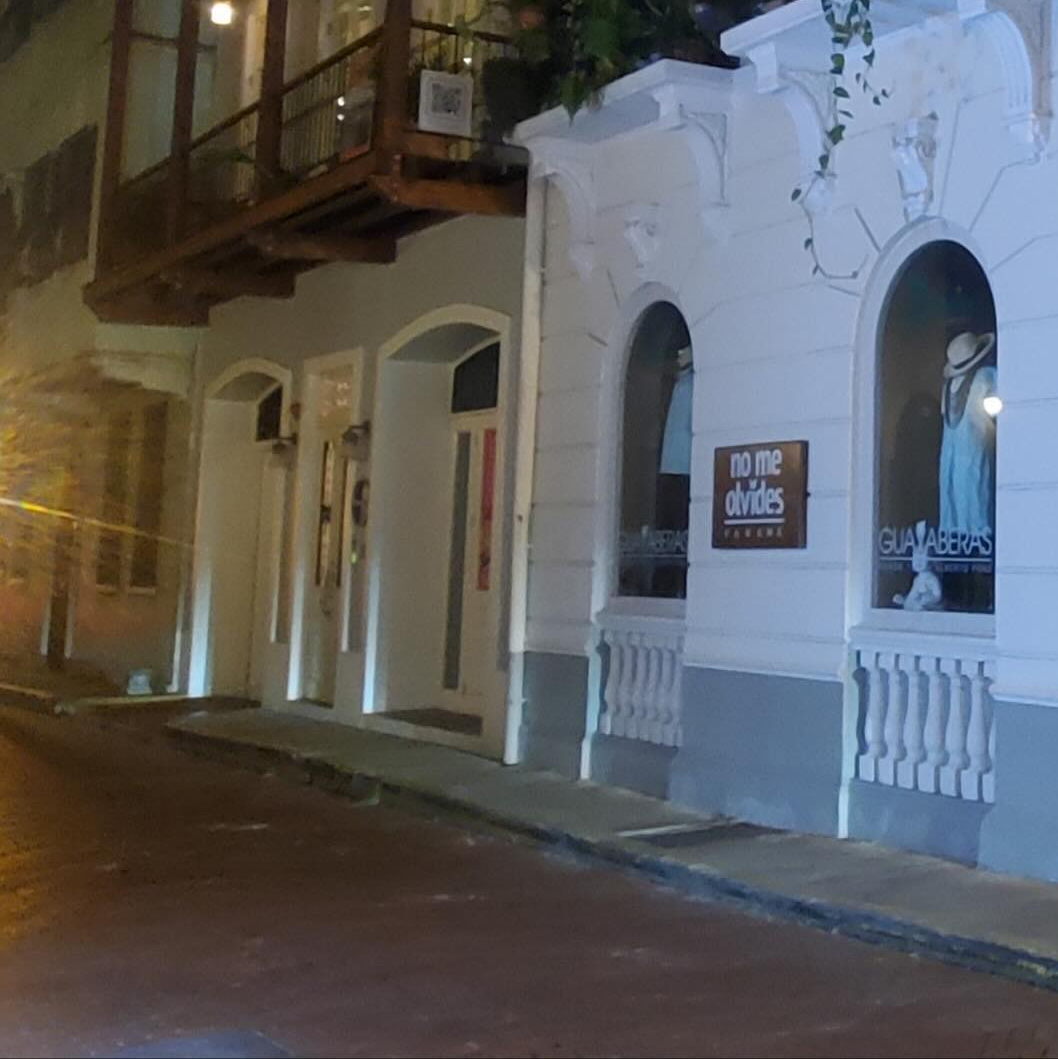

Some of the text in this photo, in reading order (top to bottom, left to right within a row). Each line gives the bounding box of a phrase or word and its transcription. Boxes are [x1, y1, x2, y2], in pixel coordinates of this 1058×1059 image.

[730, 449, 783, 479] no me
[725, 479, 785, 516] olvides
